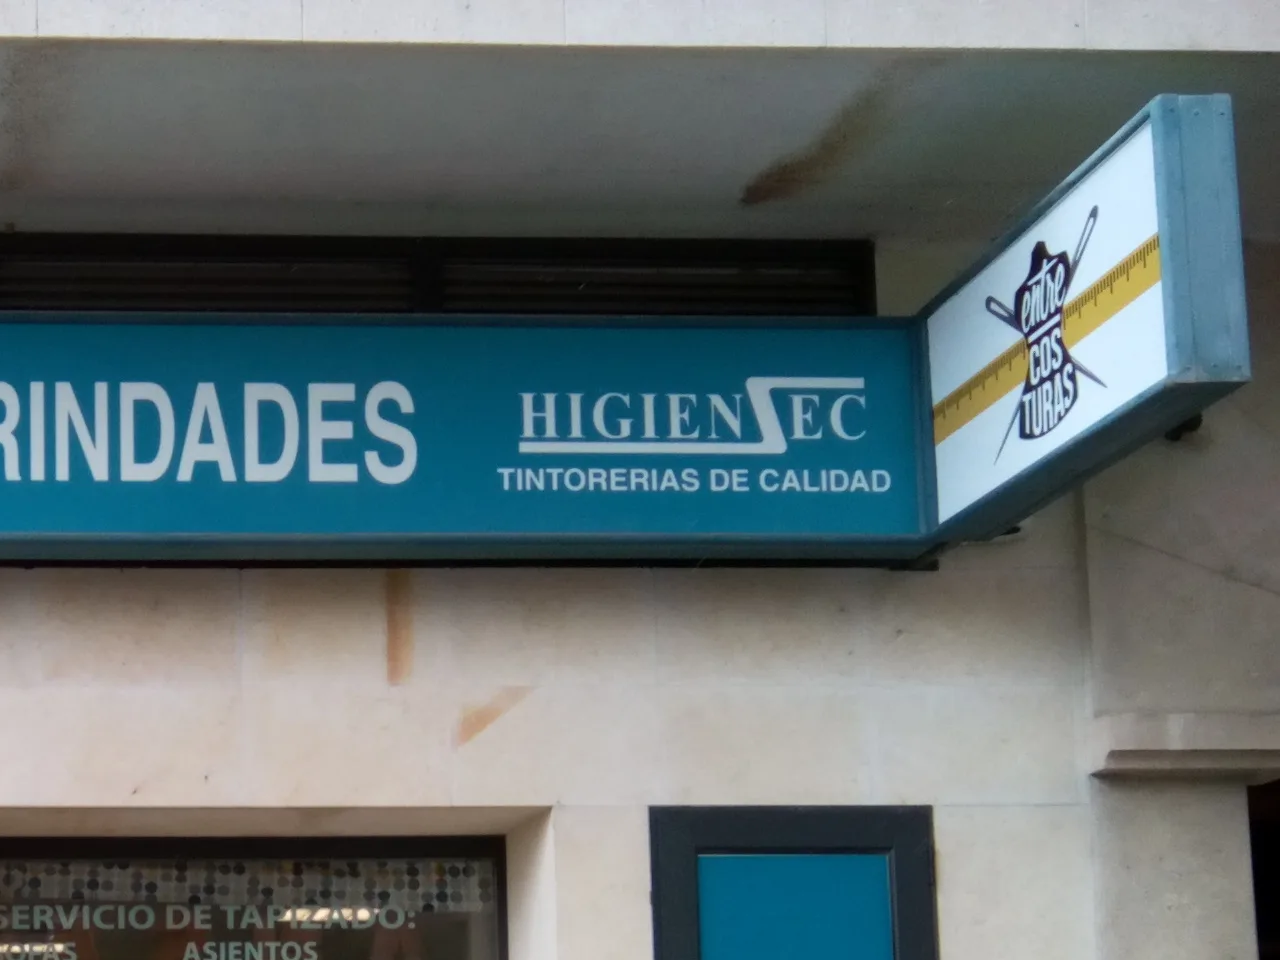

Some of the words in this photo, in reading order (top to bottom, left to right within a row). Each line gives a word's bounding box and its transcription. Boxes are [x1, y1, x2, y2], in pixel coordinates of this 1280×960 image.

[1021, 257, 1067, 334] entre
[1029, 327, 1064, 387] COS
[1022, 363, 1074, 437] TURAS
[497, 467, 699, 492] TINTORERIAS
[709, 469, 750, 492] DE
[759, 469, 891, 493] CALIDAD
[165, 904, 212, 930] DE
